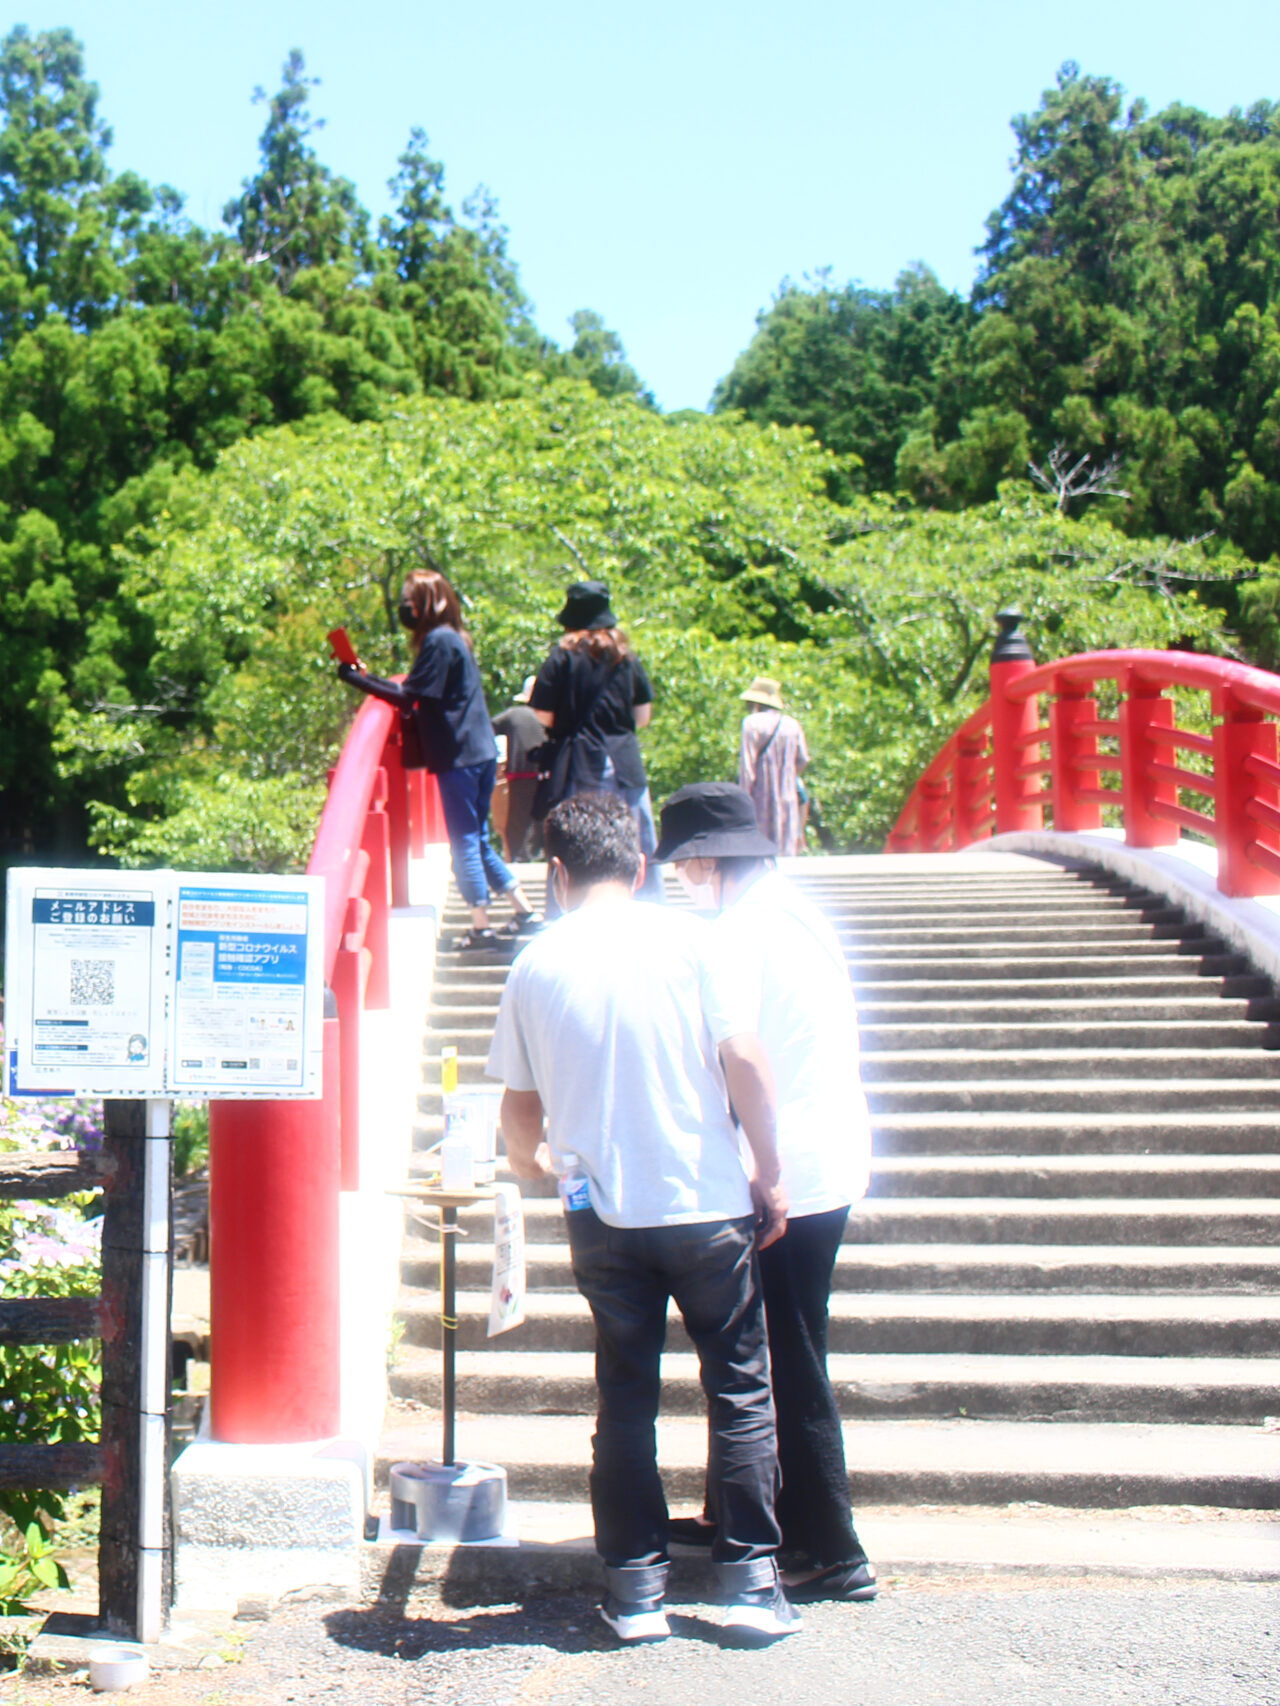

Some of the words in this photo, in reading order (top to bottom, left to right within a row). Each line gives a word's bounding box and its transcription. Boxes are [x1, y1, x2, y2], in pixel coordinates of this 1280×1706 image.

[50, 901, 135, 913] メールアドレス
[50, 912, 135, 924] ご登録のお願い
[218, 942, 297, 954] 新型コロナウイルス
